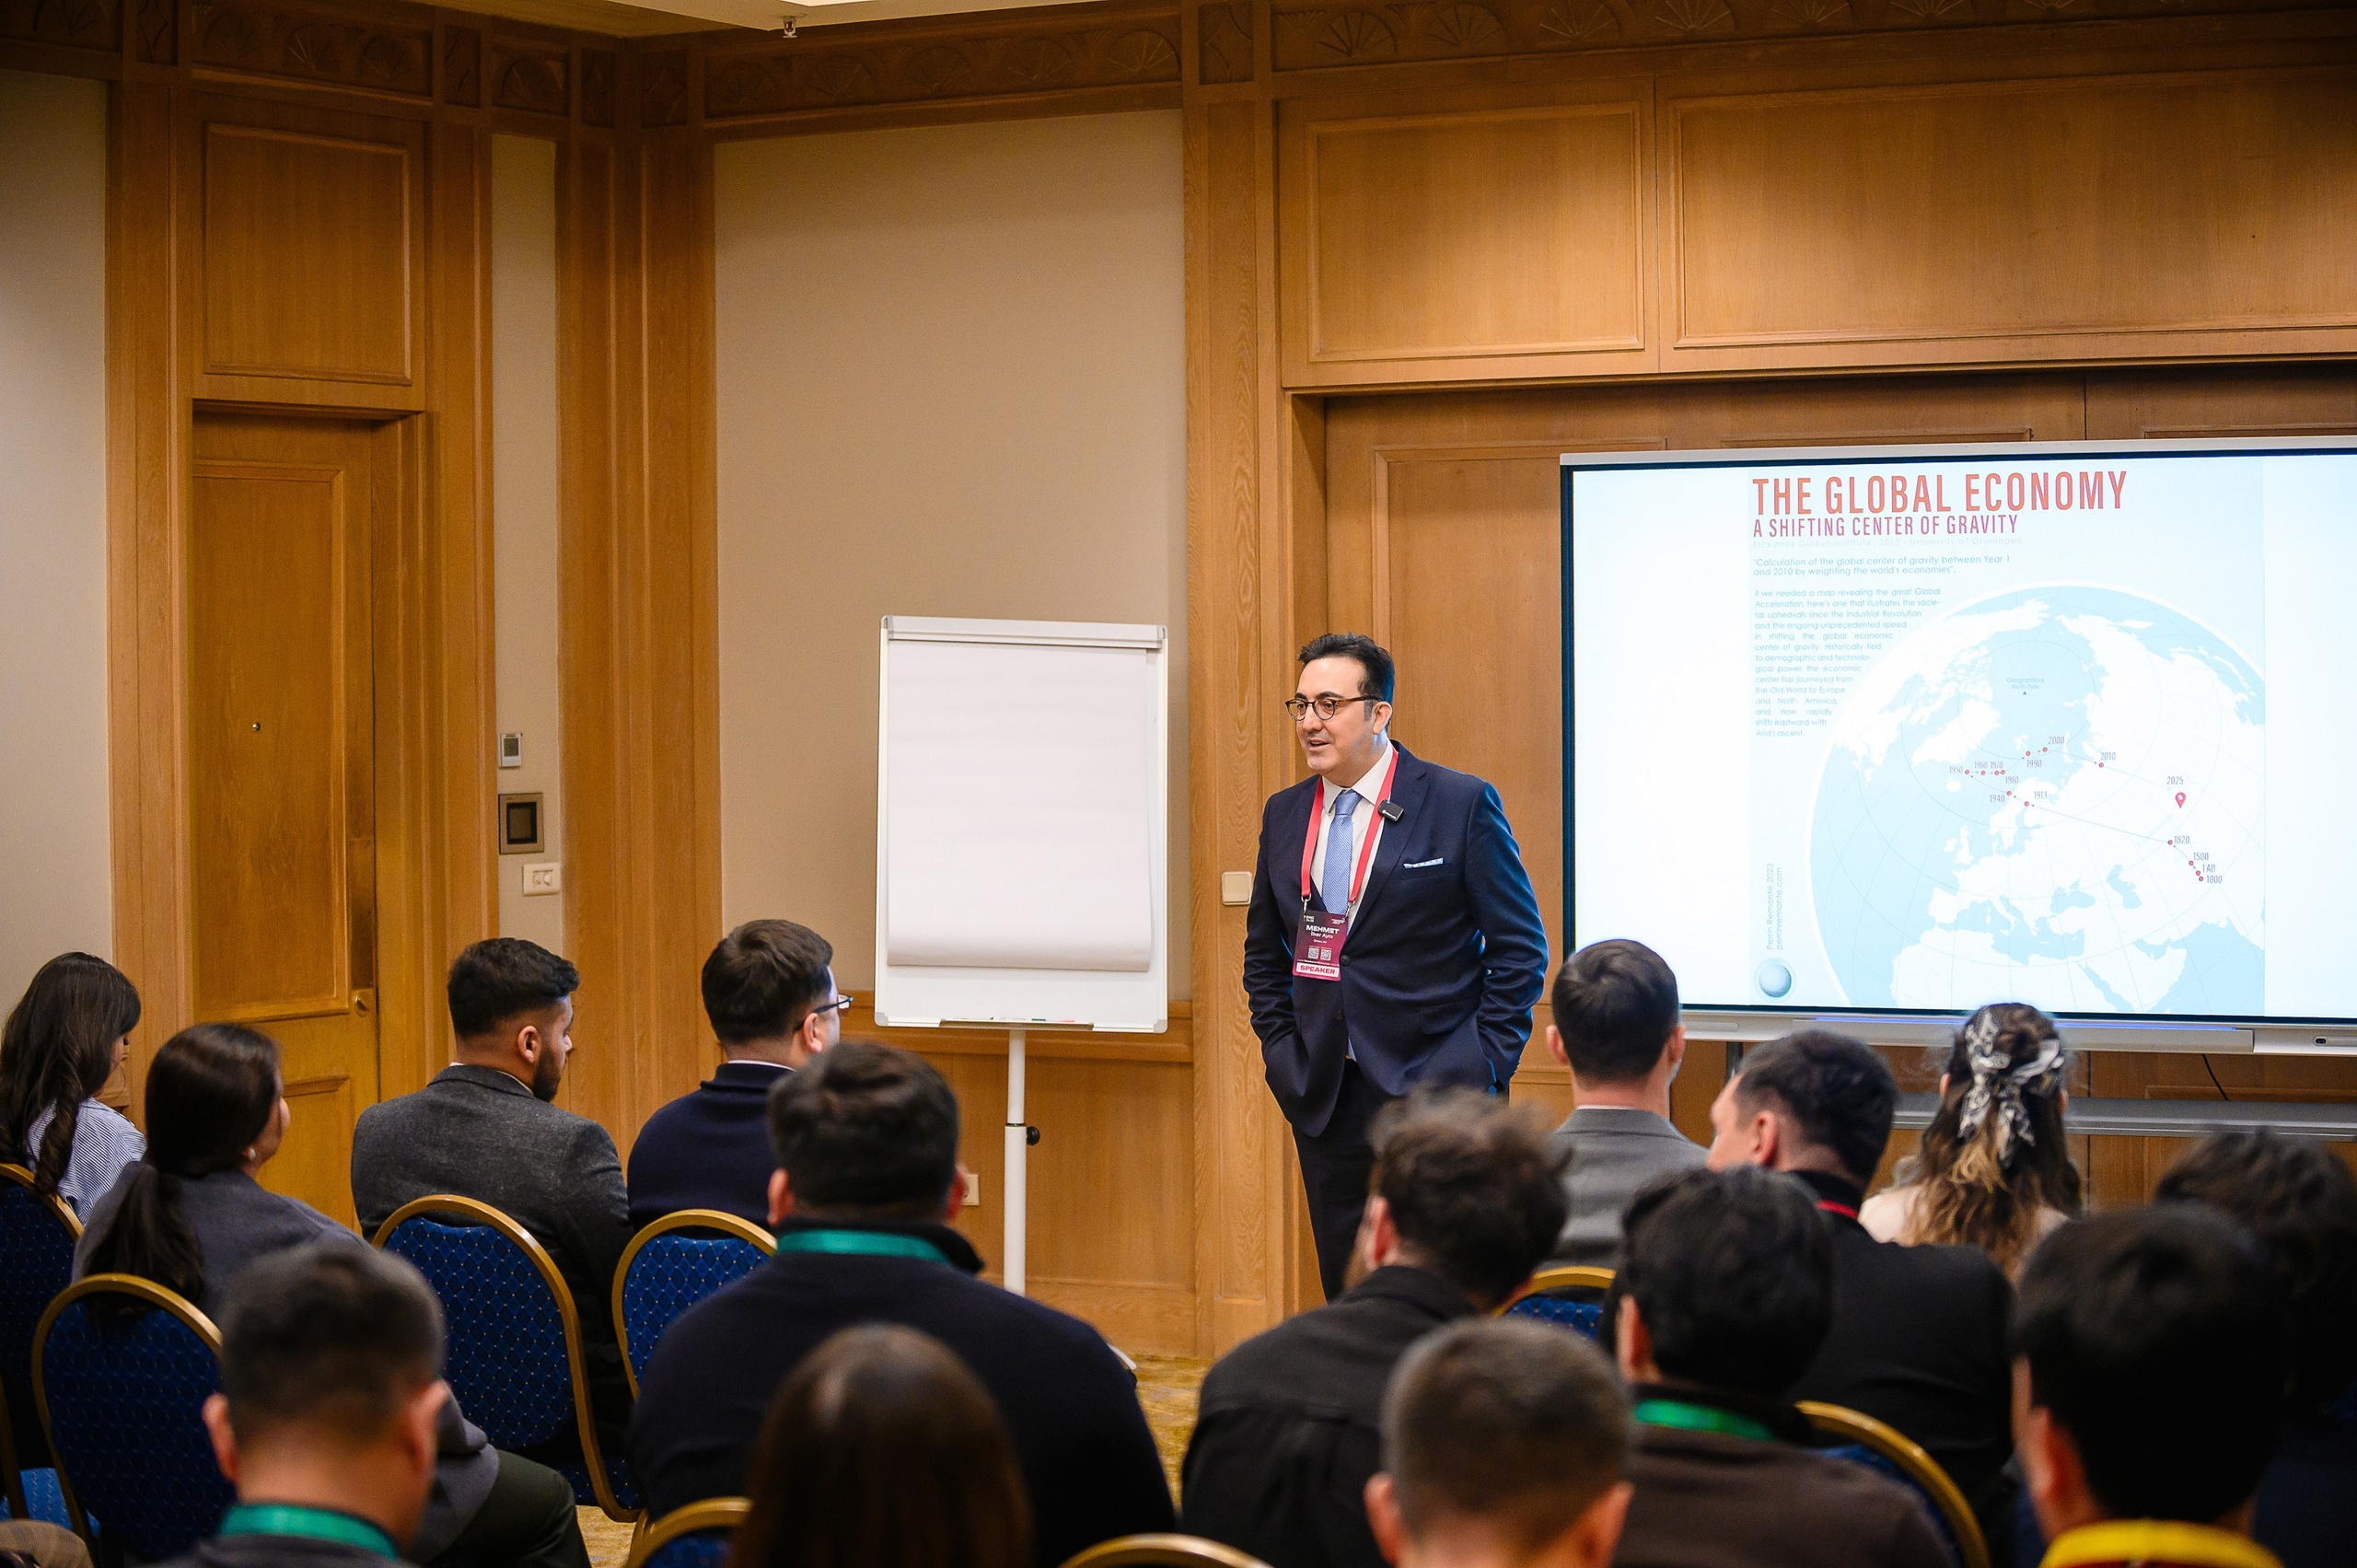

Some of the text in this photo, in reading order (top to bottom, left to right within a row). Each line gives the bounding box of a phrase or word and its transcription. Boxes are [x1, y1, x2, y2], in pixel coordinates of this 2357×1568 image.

[1752, 470, 2127, 515] THE GLOBAL ECONOMY
[1753, 514, 2017, 538] A SHIFTING CENTER OF GRAVITY
[1972, 537, 2023, 547] Groningen
[1837, 557, 1864, 567] global
[1866, 557, 1895, 565] center
[1909, 556, 1939, 565] gravity
[1942, 555, 1980, 563] between
[1983, 555, 2003, 563] Year
[1753, 568, 1771, 576] and
[1795, 567, 1806, 577] by
[1808, 567, 1851, 576] weighting
[1838, 588, 1873, 598] revealing
[1891, 588, 1911, 597] great
[1914, 587, 1941, 596] Global
[1882, 610, 1922, 618] Revolution
[1820, 621, 1880, 630] unprecedented
[1769, 633, 1794, 642] shifting
[1823, 633, 1847, 642] global
[1825, 643, 1864, 652] Historically
[1764, 654, 1817, 663] demographic
[1755, 666, 1774, 674] gical
[1795, 676, 1834, 684] journeyed
[1819, 686, 1846, 694] Europe
[2048, 737, 2065, 745] 2000
[2100, 751, 2117, 761] 2010
[1974, 761, 1988, 769] 1960
[1990, 761, 2003, 769] 1970
[2026, 760, 2042, 768] 1990
[2166, 776, 2184, 785] 2025
[1990, 795, 2005, 803] 1940
[2034, 791, 2048, 799] 1913
[2174, 835, 2189, 844] 1820
[2193, 852, 2209, 861] 1500
[1766, 863, 1774, 883] 2023
[2200, 864, 2215, 873] 1 AD
[2206, 875, 2223, 884] 1000
[1306, 924, 1340, 935] MEHMET
[1300, 965, 1335, 975] SPEAKER
